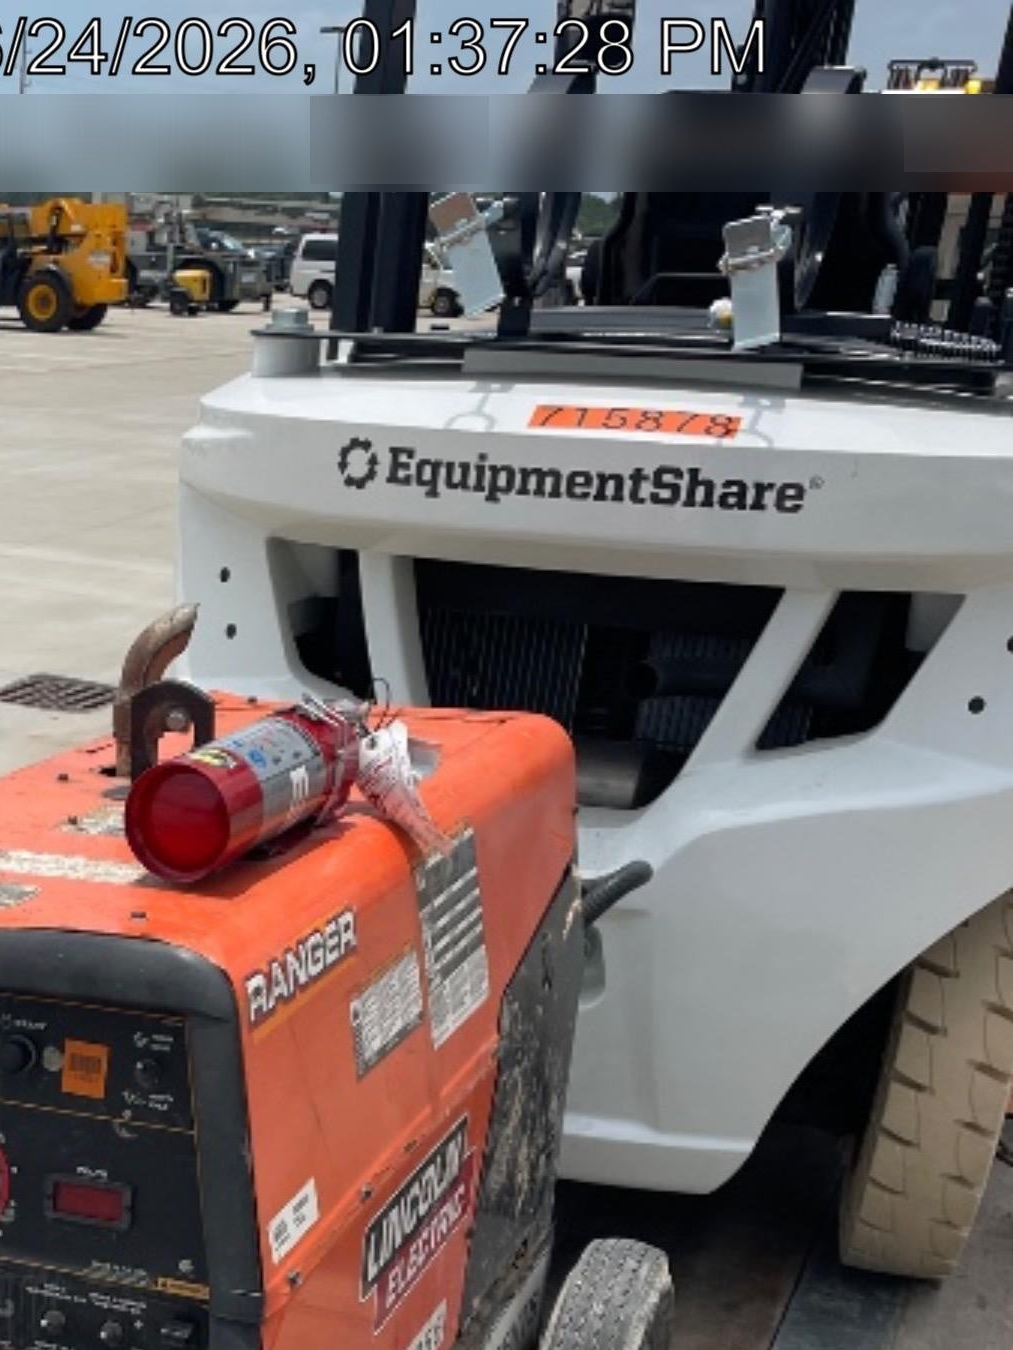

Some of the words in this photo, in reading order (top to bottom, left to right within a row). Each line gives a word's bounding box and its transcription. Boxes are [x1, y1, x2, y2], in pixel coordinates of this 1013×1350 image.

[538, 406, 735, 438] 715878
[245, 909, 357, 1023] RANGER
[367, 1130, 464, 1283] LINCOLN
[385, 1183, 466, 1309] ELECTRIC
